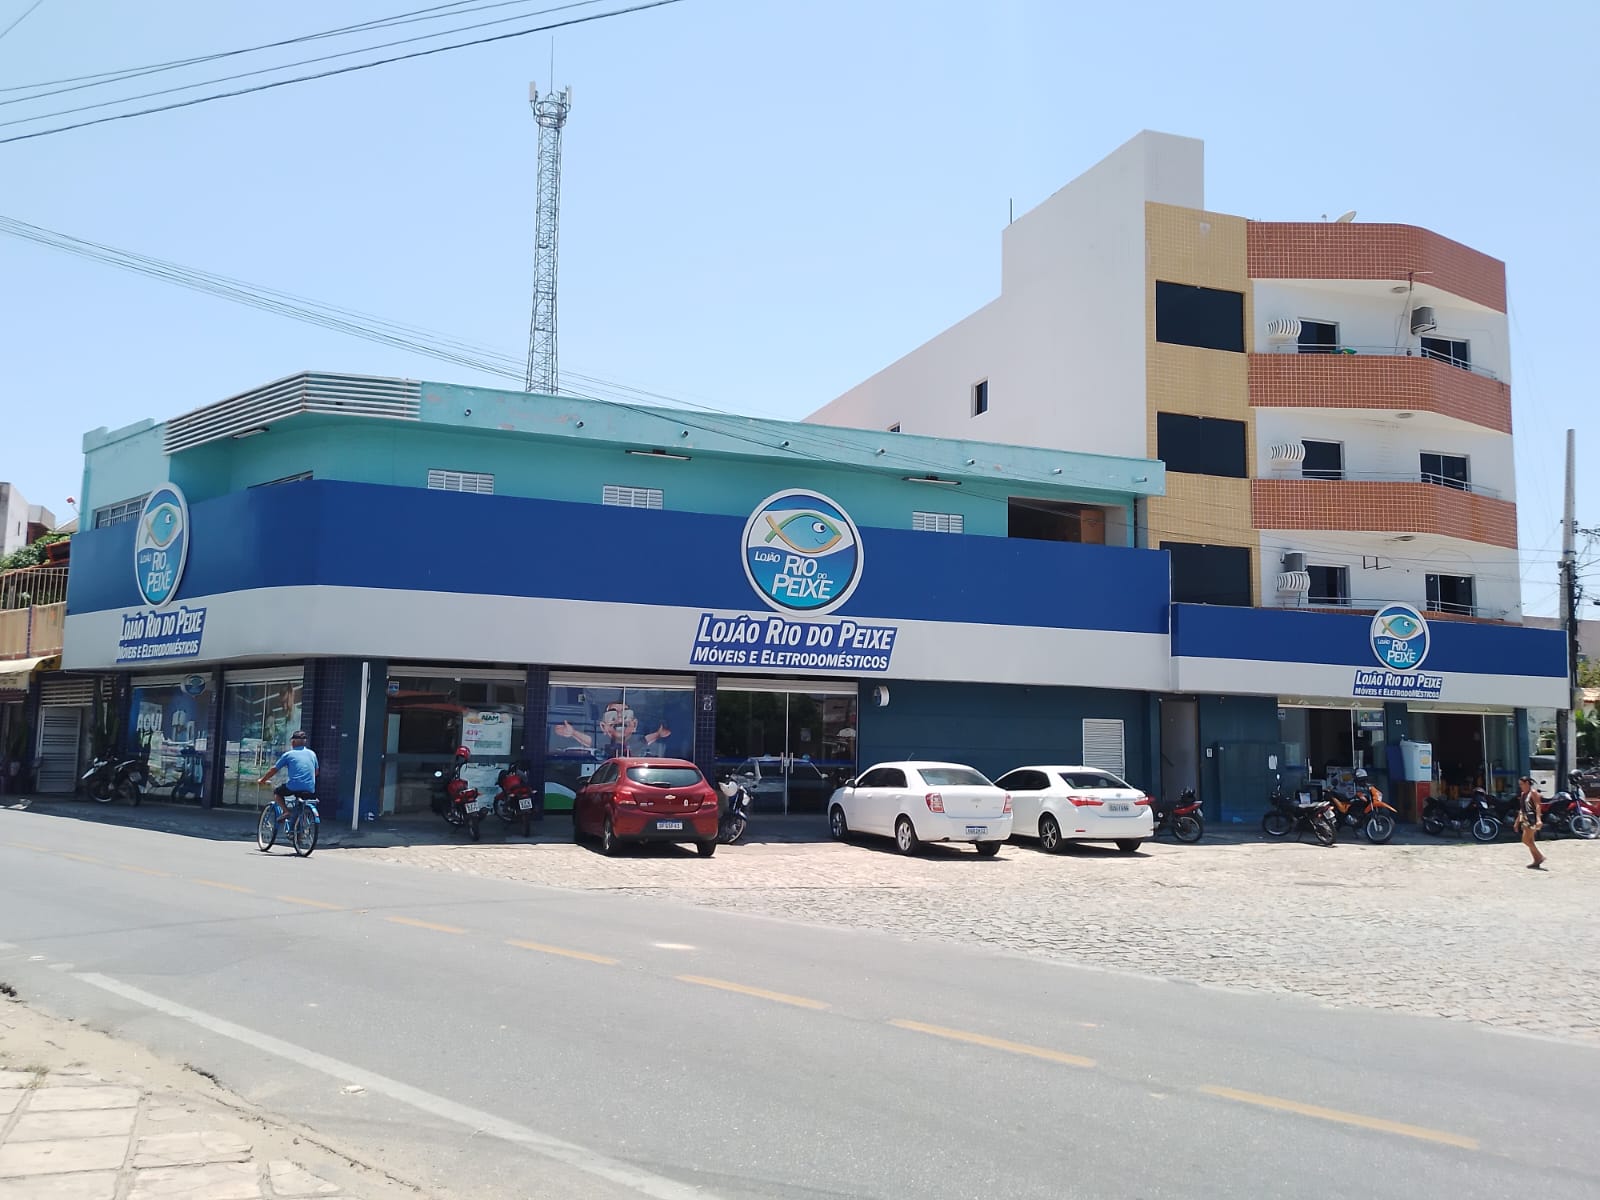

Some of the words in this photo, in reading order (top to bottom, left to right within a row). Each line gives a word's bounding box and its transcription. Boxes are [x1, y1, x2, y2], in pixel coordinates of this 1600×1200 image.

[152, 552, 167, 571] RIO
[754, 551, 780, 563] LOJÃO
[783, 555, 818, 577] RIO
[817, 572, 827, 580] DO
[146, 570, 172, 593] PEIXE
[771, 573, 833, 600] PEIXE
[145, 613, 161, 637] RIO
[161, 617, 176, 636] DO
[176, 609, 203, 635] PEIXE
[698, 615, 759, 644] LOJÃO
[765, 619, 802, 646] RIO
[806, 627, 833, 647] DO
[838, 622, 894, 650] PEIXE
[137, 646, 142, 658] E
[694, 645, 746, 663] MÓVEIS
[749, 651, 758, 664] E
[761, 649, 888, 669] ELETRODOMÉSTICOS
[1387, 650, 1416, 663] PEIXE
[1392, 640, 1408, 651] RIO
[1355, 671, 1383, 685] LOJÃO
[1385, 673, 1400, 686] RIO
[1403, 676, 1415, 687] DO
[1417, 675, 1442, 688] PEIXE
